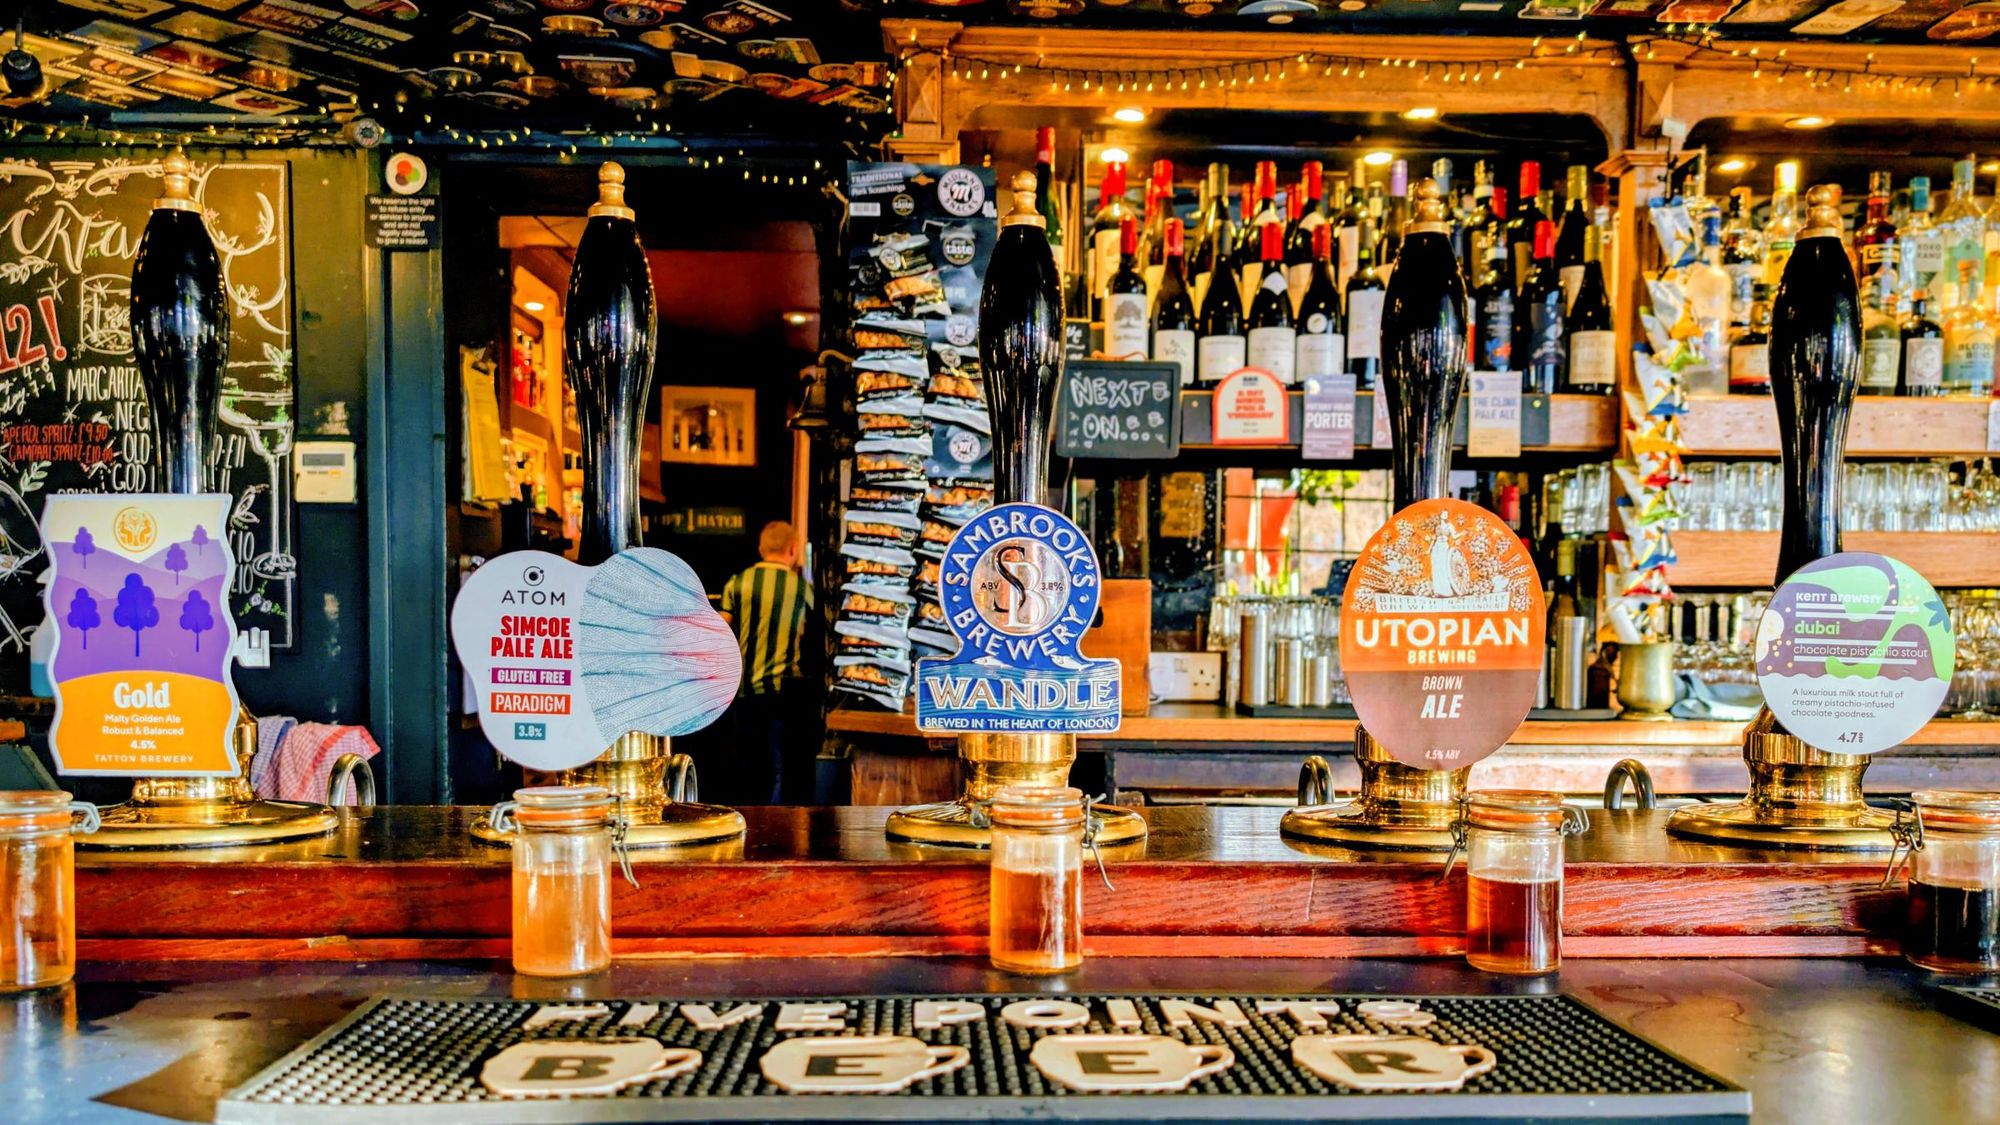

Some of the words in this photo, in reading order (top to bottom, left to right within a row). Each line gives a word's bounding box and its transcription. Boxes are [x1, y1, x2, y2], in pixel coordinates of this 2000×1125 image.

[850, 171, 904, 184] TRADITIONAL
[868, 184, 907, 195] Scratchings
[369, 197, 382, 205] We
[383, 198, 408, 206] reserve
[408, 197, 420, 206] the
[420, 198, 436, 207] right
[387, 205, 409, 213] refuse
[409, 206, 426, 215] entry
[378, 213, 403, 221] service
[402, 213, 411, 221] to
[411, 214, 436, 223] anyone
[383, 221, 397, 229] and
[378, 229, 400, 238] legally
[400, 229, 426, 238] obliged
[376, 237, 384, 245] to
[384, 236, 399, 246] give
[405, 238, 429, 246] reason
[1069, 375, 1151, 409] NEXT
[1305, 412, 1354, 429] PORTER
[2, 424, 40, 444] APEROL
[8, 444, 53, 463] CAMPARI
[122, 431, 151, 465] OLD
[696, 513, 743, 529] HATCH
[944, 510, 1096, 589] SAMBROOK'S
[980, 581, 1001, 591] ABV
[1041, 581, 1065, 592] 3.8%
[501, 589, 566, 606] ATOM
[500, 615, 571, 638] SIMCOE
[952, 604, 1087, 661] BREWERY
[1354, 617, 1530, 648] UTOPIAN
[1794, 620, 1841, 635] dubai
[490, 636, 535, 658] PALE
[540, 638, 573, 660] ALE
[1793, 644, 1847, 656] chocolate
[1850, 646, 1900, 659] pistachio
[1901, 647, 1928, 658] stout
[1407, 649, 1477, 664] BREWING
[497, 669, 537, 683] GLUTEN
[540, 671, 565, 685] FREE
[1421, 676, 1464, 690] BROWN
[113, 681, 171, 709] Gold
[925, 674, 1115, 711] WANDLE
[1791, 688, 1799, 696] A
[1800, 688, 1838, 697] luxurious
[1838, 689, 1857, 698] milk
[1857, 689, 1879, 698] stout
[1880, 689, 1894, 698] full
[1894, 688, 1905, 698] of
[495, 694, 567, 713] PARADIGM
[1420, 694, 1464, 719] ALE
[1791, 699, 1824, 709] creamy
[1824, 698, 1896, 709] pistachio-infused
[105, 714, 130, 725] Malty
[131, 713, 164, 724] Golden
[165, 713, 182, 724] Ale
[1791, 707, 1833, 717] chocolate
[1834, 710, 1876, 719] goodness.
[924, 718, 970, 728] BREWED
[971, 718, 984, 728] IN
[989, 718, 1010, 728] THE
[1011, 718, 1046, 729] HEART
[1047, 718, 1064, 728] OF
[1065, 717, 1115, 728] LONDON
[102, 726, 134, 736] Robust
[135, 726, 142, 736] &
[143, 726, 184, 736] Balanced
[518, 725, 543, 738] 3.8%
[1838, 731, 1864, 743] 4.7%
[130, 739, 156, 750] 4.5%
[94, 754, 136, 763] TATTON
[141, 754, 194, 764] BREWERY
[1424, 749, 1443, 760] 4.5%
[1444, 749, 1460, 760] ABV
[524, 1002, 849, 1032] FIVE
[912, 999, 1440, 1029] POINTS
